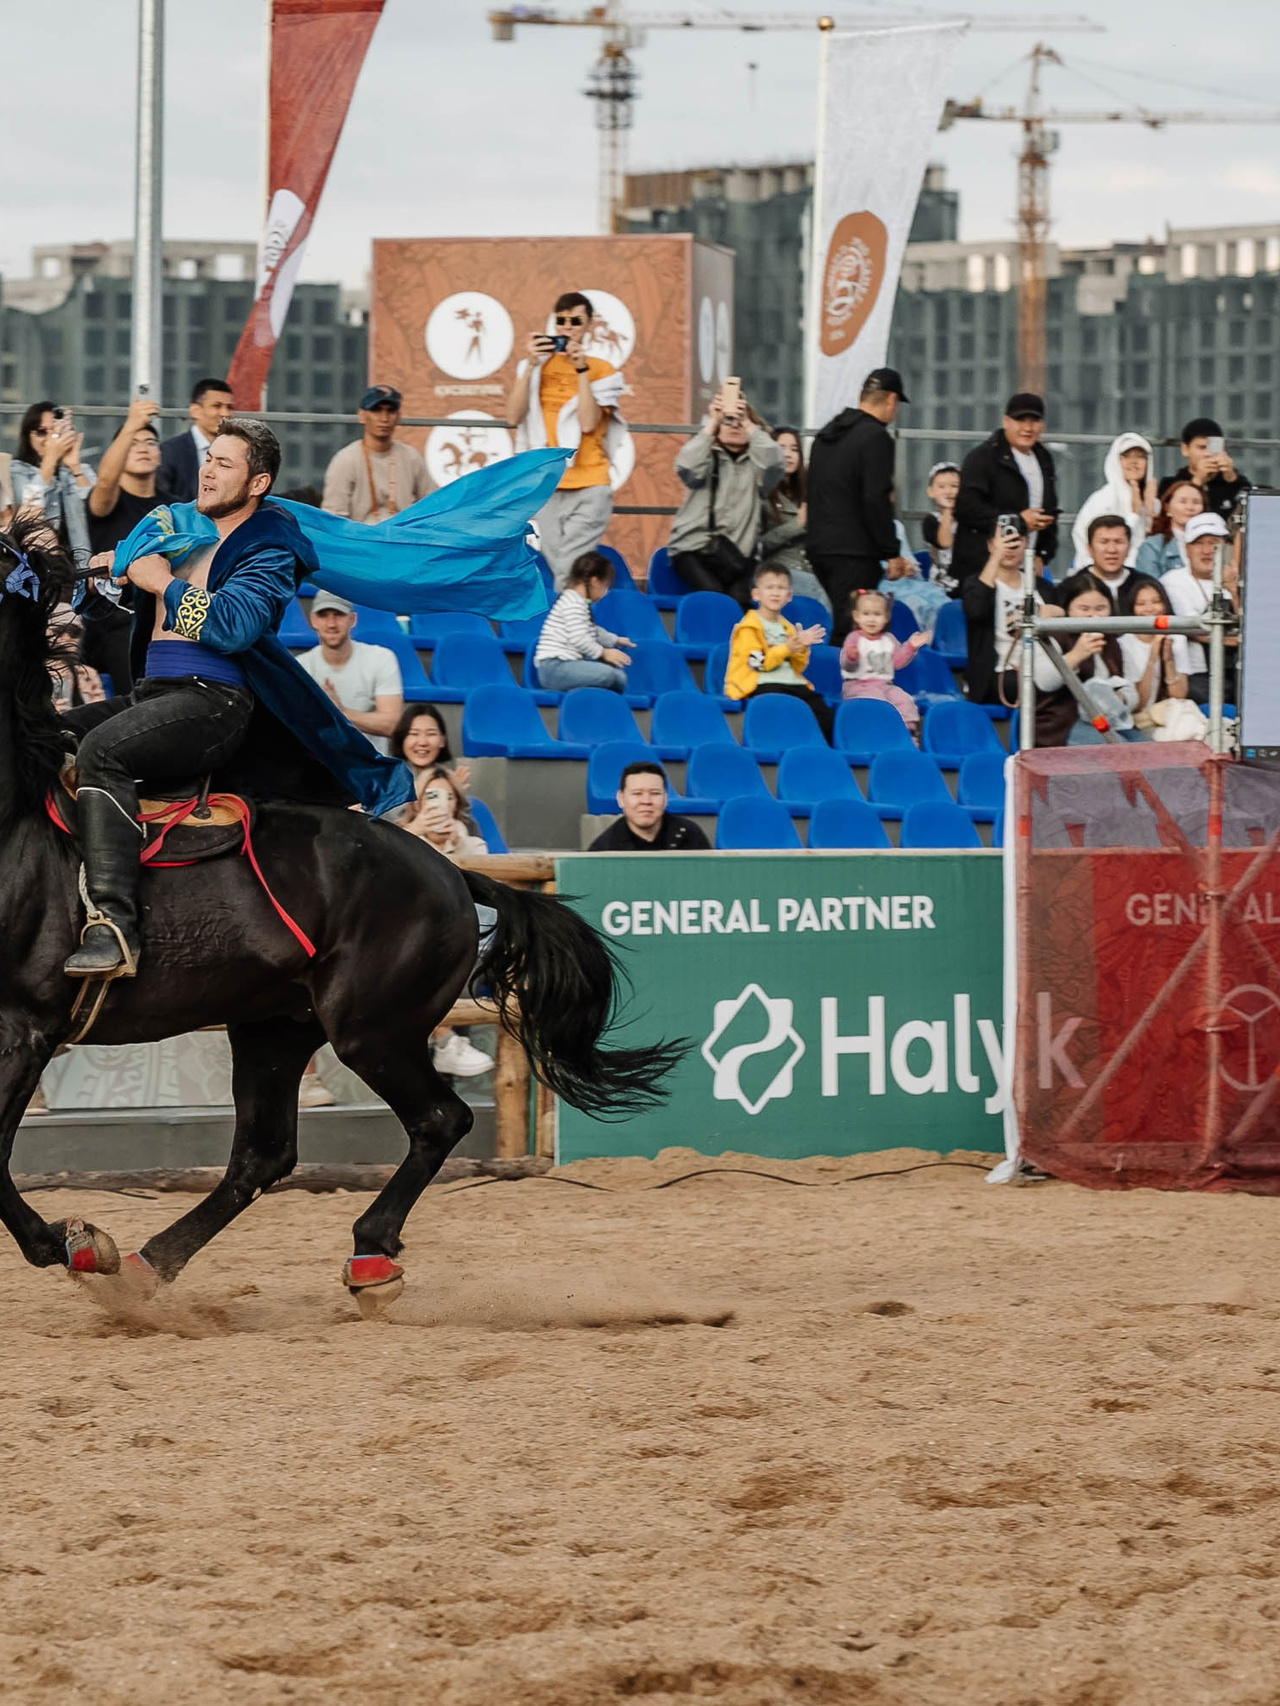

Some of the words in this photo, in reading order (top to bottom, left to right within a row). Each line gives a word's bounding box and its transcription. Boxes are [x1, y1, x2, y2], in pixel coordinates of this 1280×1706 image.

[601, 899, 770, 936] GENERAL
[777, 895, 936, 932] PARTNER
[1126, 892, 1280, 926] GENAL
